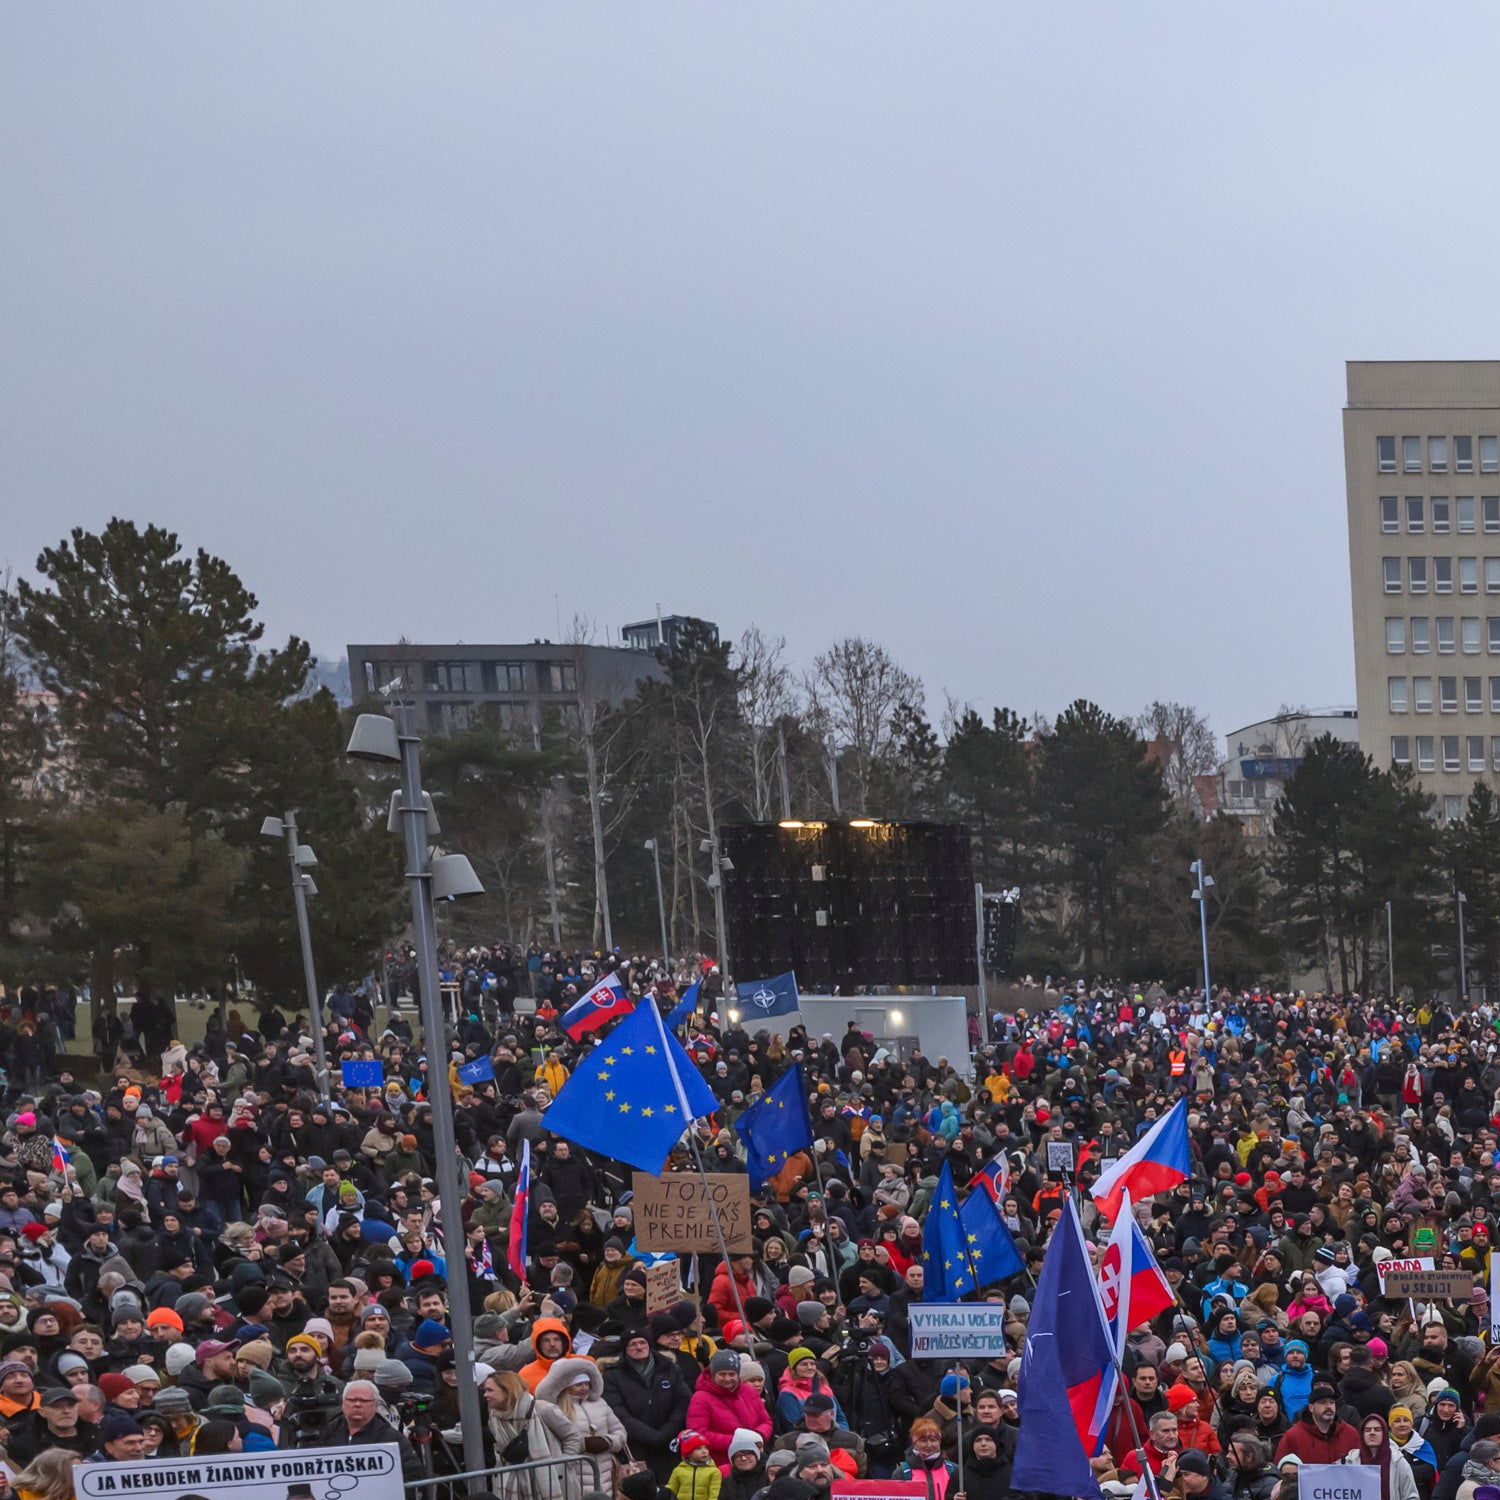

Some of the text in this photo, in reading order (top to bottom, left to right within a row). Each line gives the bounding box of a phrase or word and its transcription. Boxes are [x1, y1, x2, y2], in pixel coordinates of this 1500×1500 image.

[660, 1181, 729, 1202] TOTO
[643, 1203, 697, 1219] NIE JE
[913, 1312, 966, 1328] VYHRAJ
[97, 1455, 385, 1491] JA NEBUDEM ŽIADNY PODRŽTAŠKA!
[1312, 1488, 1362, 1500] CHCEM
